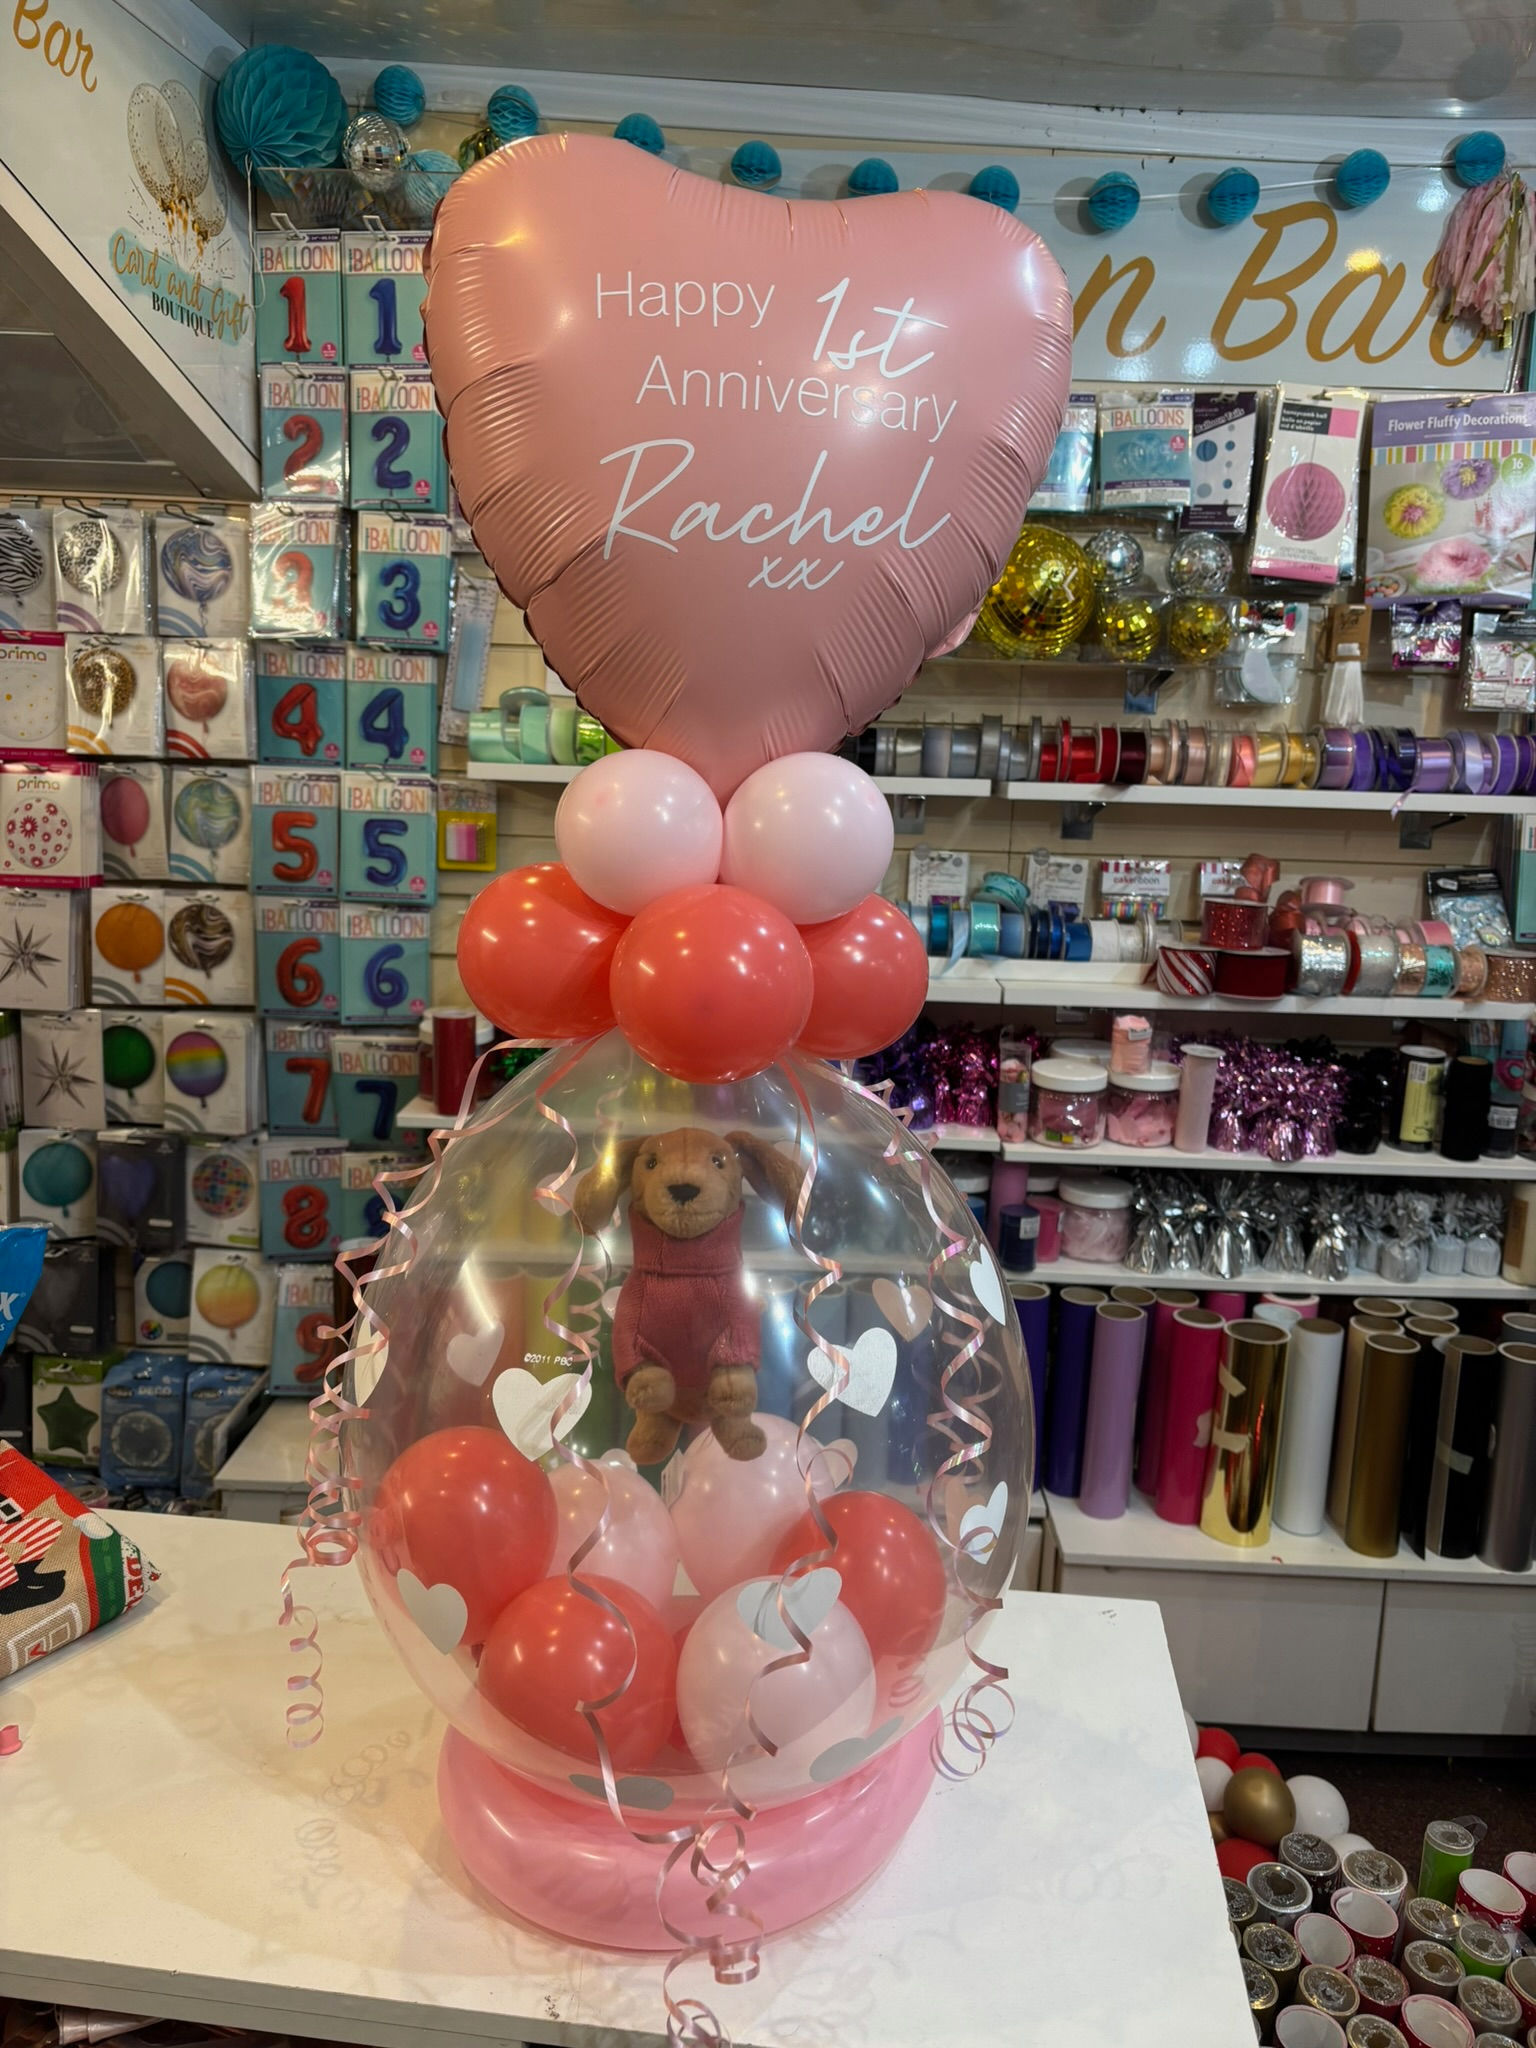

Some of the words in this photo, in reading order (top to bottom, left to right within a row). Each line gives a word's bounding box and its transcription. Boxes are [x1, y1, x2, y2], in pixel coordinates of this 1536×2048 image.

[14, 0, 97, 92] Bar
[265, 246, 334, 272] BALLOON
[113, 234, 160, 289] Card
[167, 272, 204, 311] and
[211, 288, 251, 341] Gift
[280, 276, 312, 353] 1
[152, 291, 215, 340] BOUTIQUE
[369, 278, 402, 354] 1
[596, 271, 775, 329] Happy
[813, 277, 949, 379] 1st
[273, 383, 339, 408] BALLOON
[361, 386, 430, 411] BALLOON
[635, 354, 957, 443] Anniversary
[1114, 408, 1185, 428] BALLOONS
[1388, 418, 1425, 432] Flower
[1427, 415, 1461, 430] Fluffy
[1463, 413, 1528, 426] Decorations
[371, 416, 413, 489] 2
[1511, 457, 1524, 470] 16
[600, 438, 951, 560] Rachel
[369, 528, 441, 553] BALLOON
[378, 559, 421, 631] 3
[748, 556, 844, 590] xx
[267, 653, 340, 677] BALLOON
[356, 657, 425, 681] BALLOON
[272, 683, 323, 757] 4
[359, 687, 409, 759] 4
[17, 776, 60, 792] prima
[263, 782, 333, 804] BALLOON
[352, 786, 426, 812] BALLOON
[272, 811, 318, 883] 5
[363, 818, 408, 887] 5
[265, 908, 336, 931] BALLOON
[352, 914, 425, 937] BALLOON
[276, 937, 324, 1008] 6
[363, 943, 409, 1008] 6
[343, 1052, 412, 1073] BALLOON
[285, 1057, 332, 1125] 7
[355, 1080, 397, 1140] 7
[270, 1157, 342, 1179] BALLOON
[282, 1184, 329, 1249] 8
